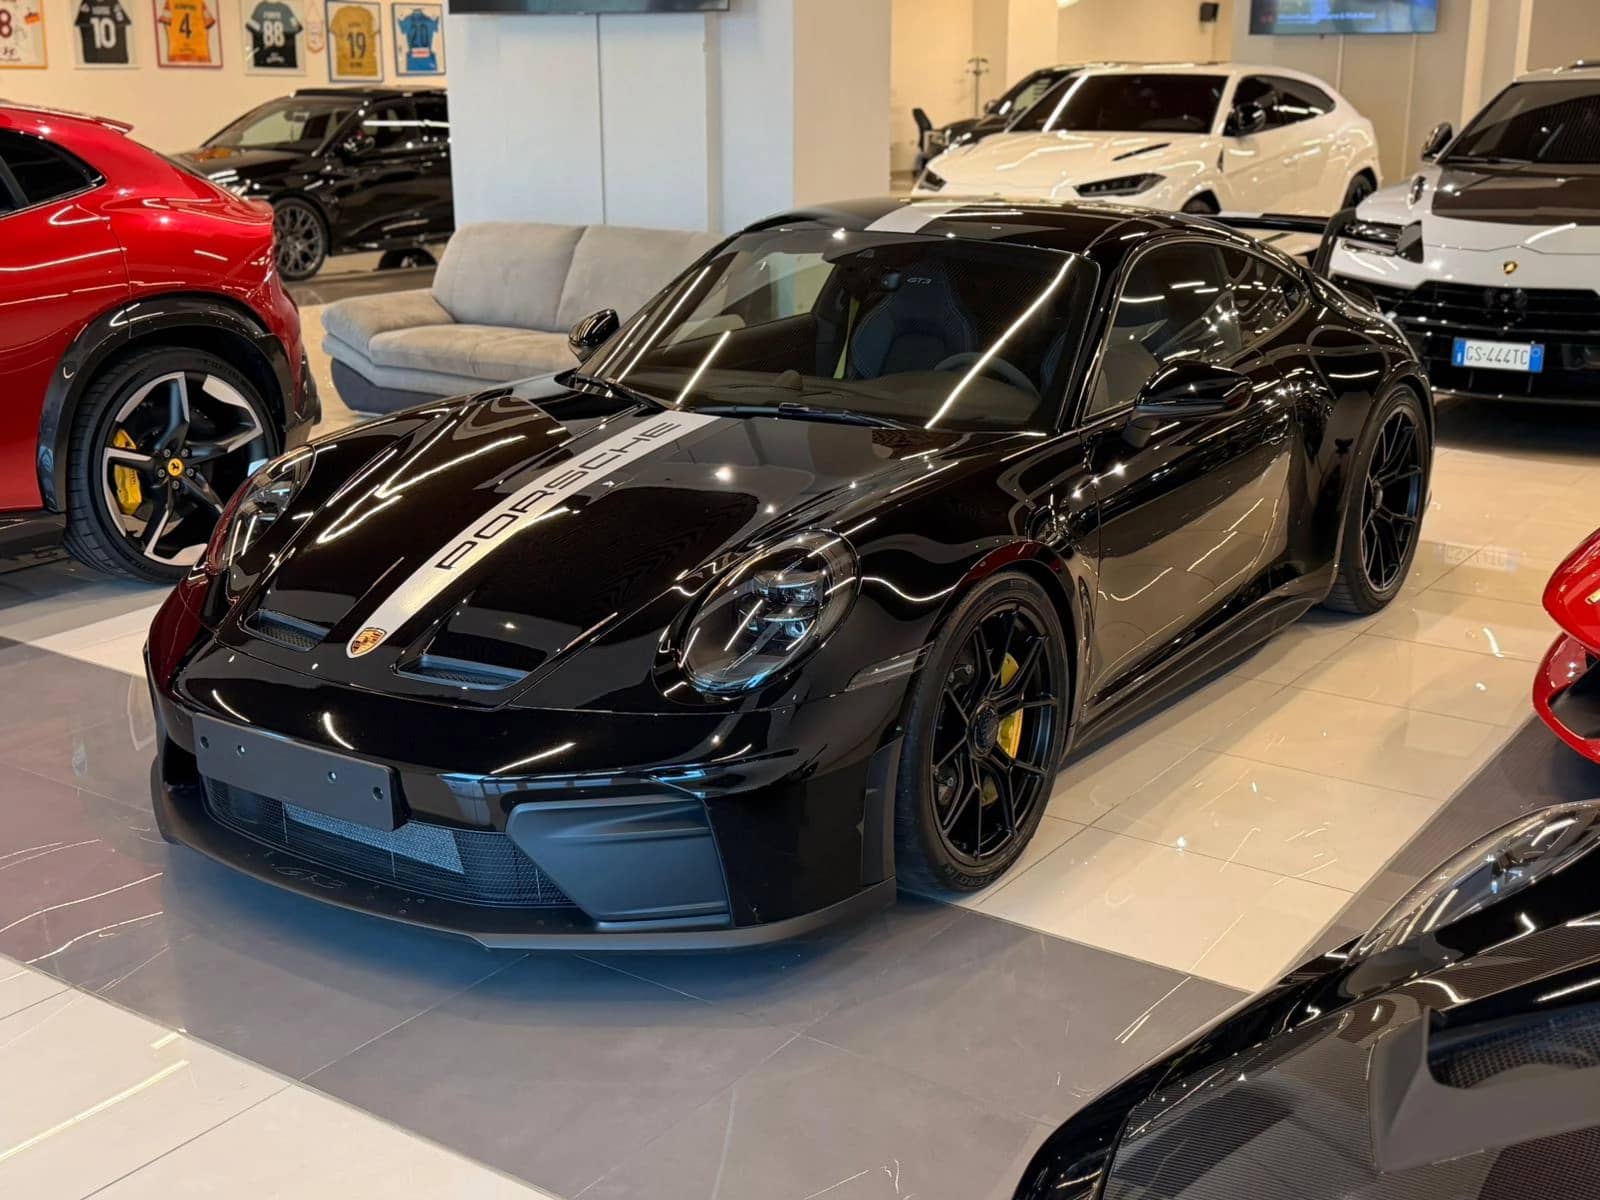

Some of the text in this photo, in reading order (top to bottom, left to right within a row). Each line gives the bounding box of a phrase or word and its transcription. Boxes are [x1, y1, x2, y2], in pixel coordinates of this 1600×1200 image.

[90, 17, 117, 48] 10
[179, 12, 193, 39] 4
[263, 20, 285, 48] 88
[346, 31, 366, 59] 19
[434, 421, 682, 571] PORSCHE
